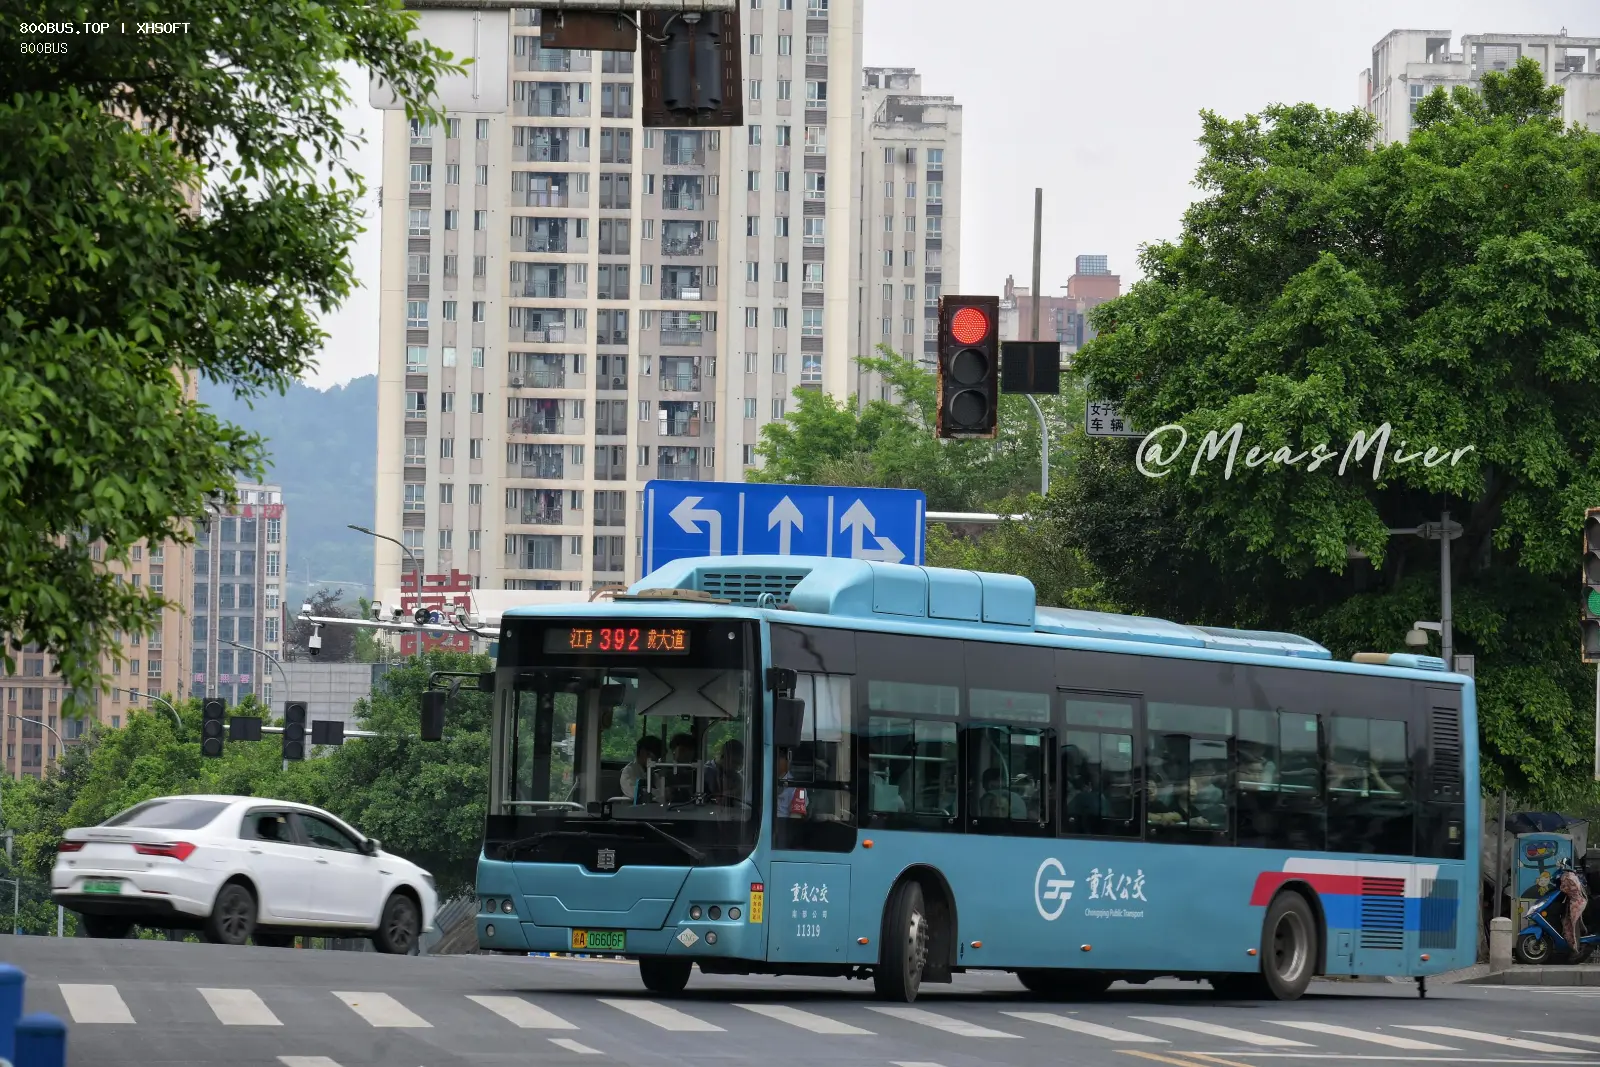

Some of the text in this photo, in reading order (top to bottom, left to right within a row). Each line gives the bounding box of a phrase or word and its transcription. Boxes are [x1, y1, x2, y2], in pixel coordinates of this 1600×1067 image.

[599, 628, 640, 651] 392
[790, 882, 829, 903] 重庆公交
[1085, 867, 1148, 902] 重庆公交
[1109, 908, 1123, 917] Public
[1123, 909, 1144, 919] Transport
[796, 924, 821, 937] 11319
